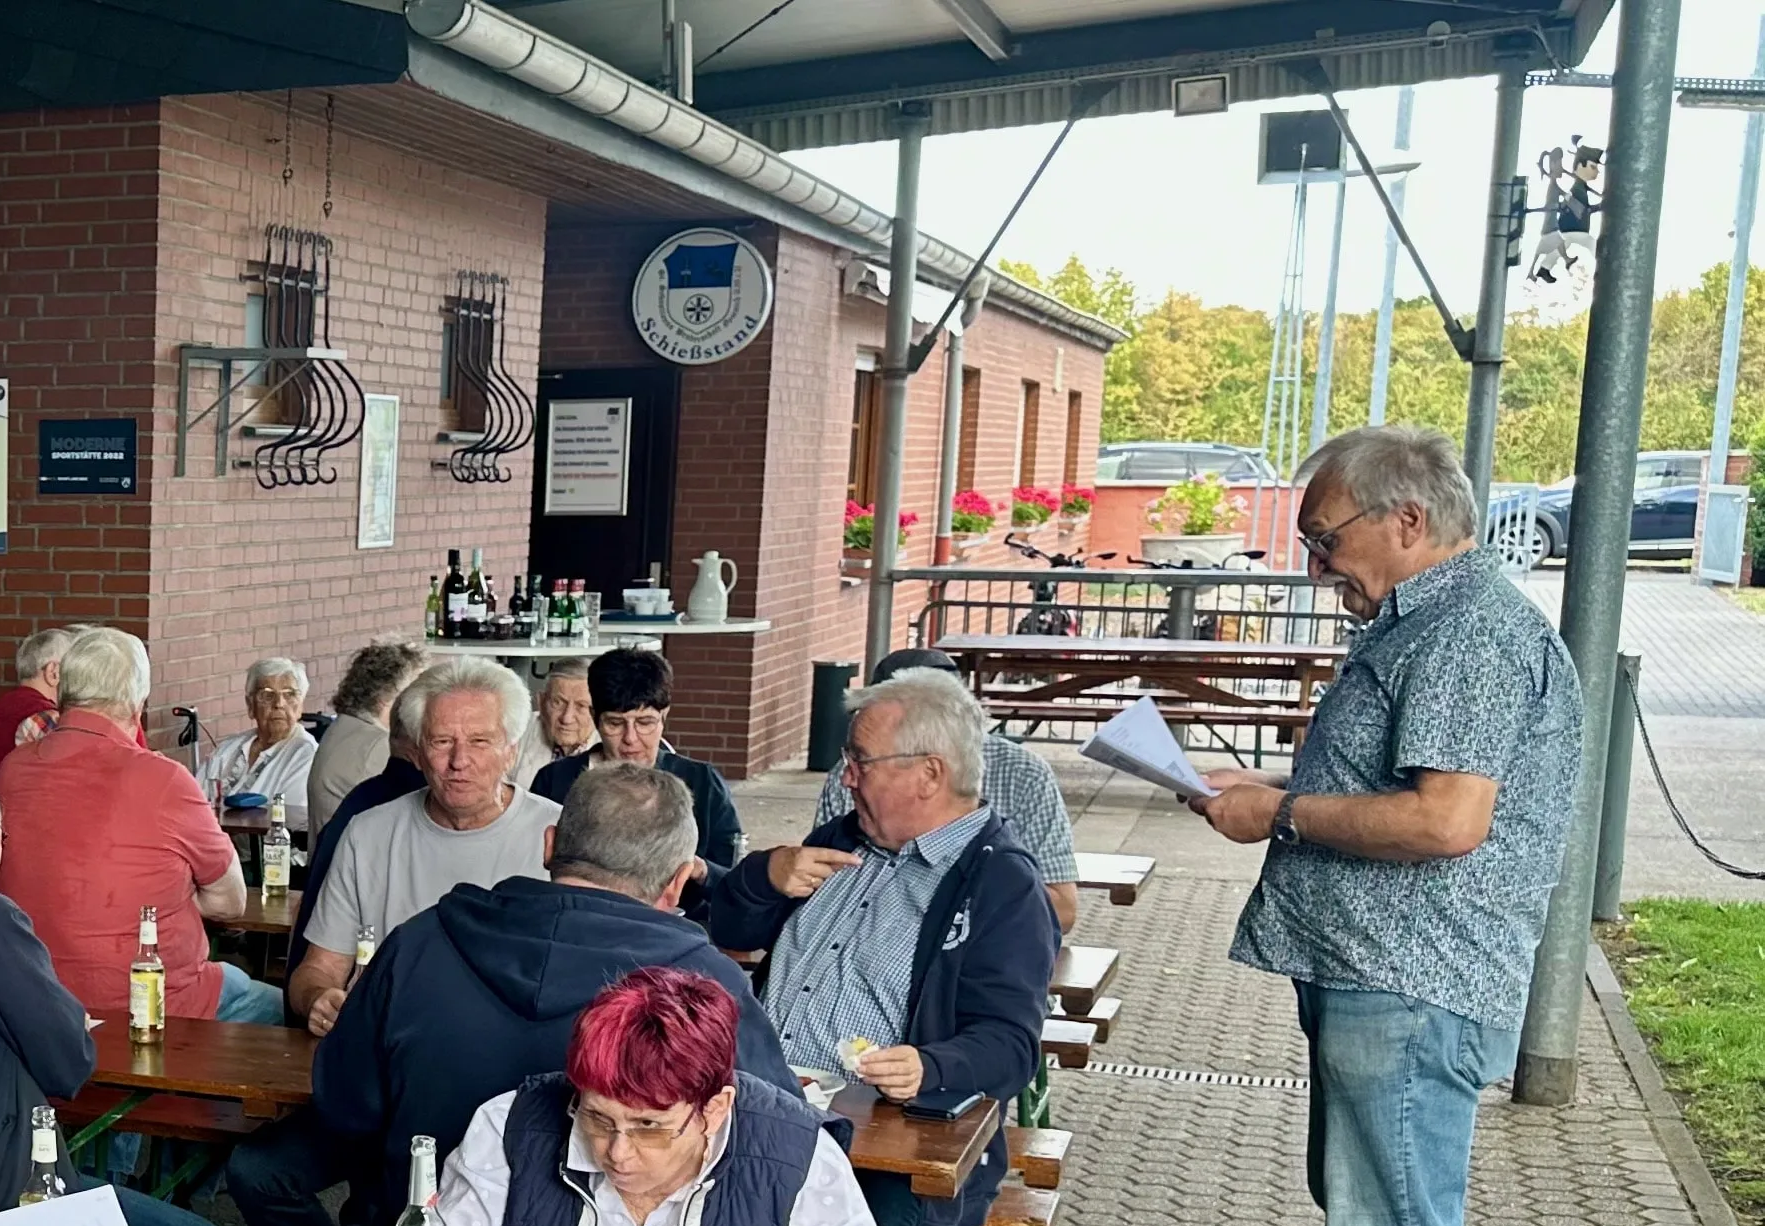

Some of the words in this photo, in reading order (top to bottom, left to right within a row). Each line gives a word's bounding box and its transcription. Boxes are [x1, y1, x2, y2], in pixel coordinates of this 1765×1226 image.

[640, 315, 757, 360] Schießstand
[51, 437, 126, 451] MODERNE
[51, 450, 101, 460] SPORTSTÄTTE
